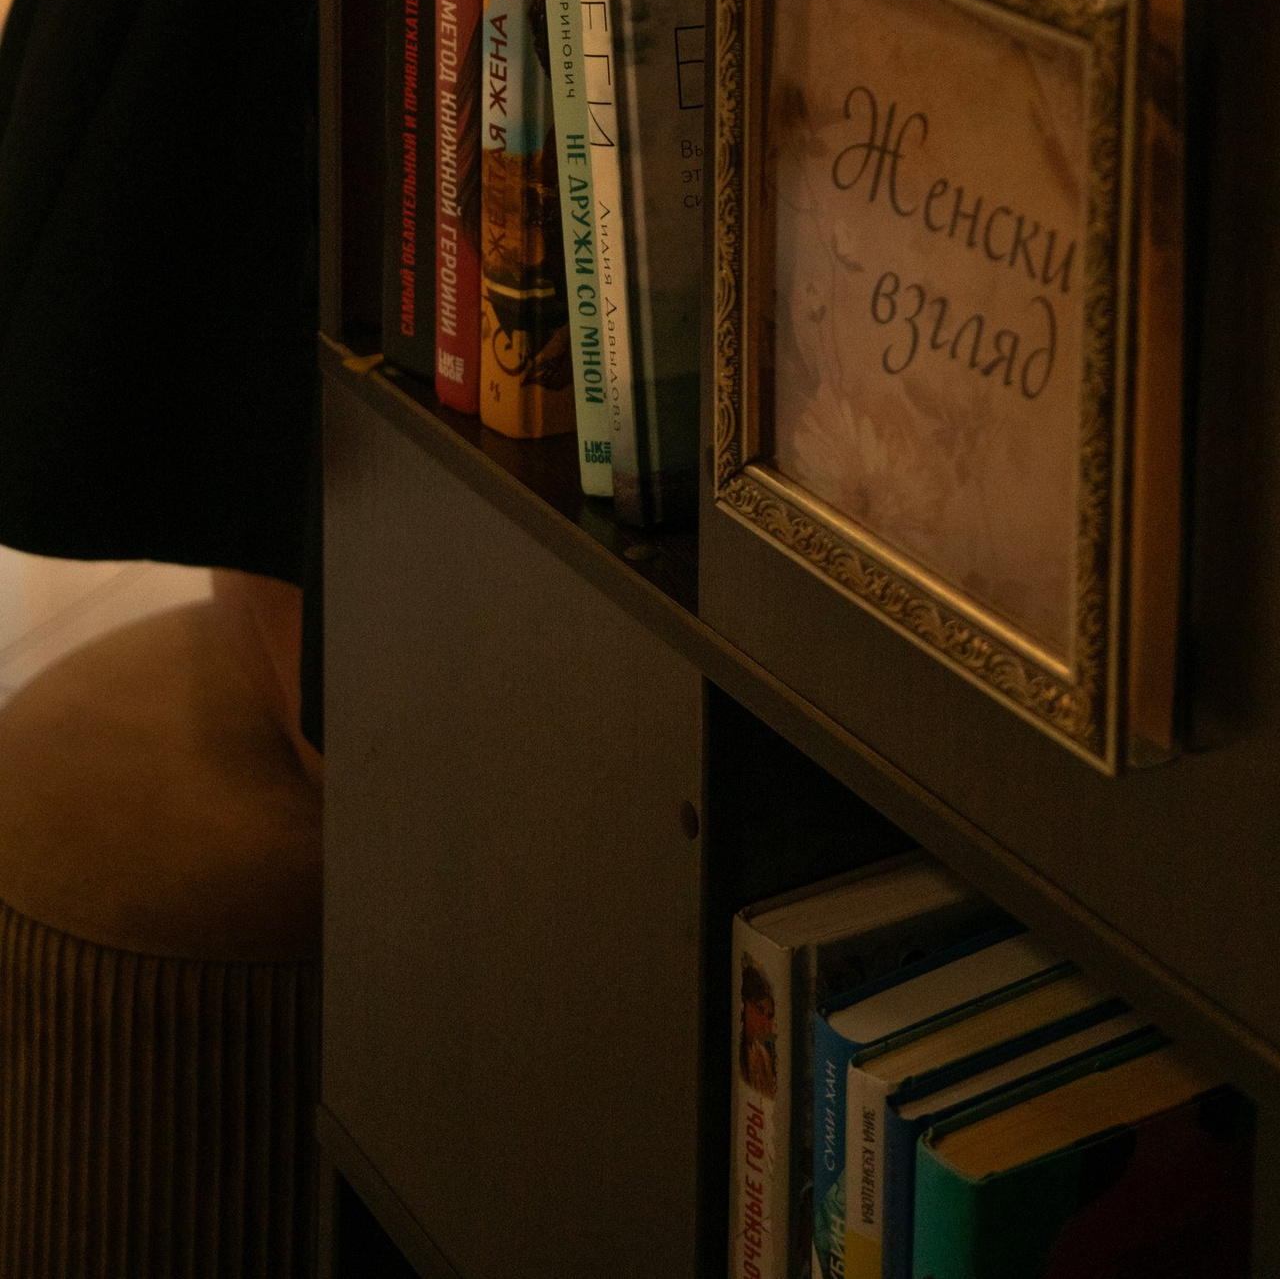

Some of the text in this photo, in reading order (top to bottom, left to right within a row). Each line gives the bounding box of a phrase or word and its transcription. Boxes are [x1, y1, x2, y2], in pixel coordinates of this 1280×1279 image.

[489, 13, 508, 116] ЖЕНА
[440, 0, 462, 337] МЕТОД КНИЖНОЙ ГЕРОИНИ
[831, 85, 1076, 294] Женски
[566, 134, 607, 405] НЕ ДРУЖИ СО МНОЙ
[871, 270, 1058, 400] взгляд
[584, 440, 612, 454] LIKE
[584, 452, 612, 465] BOOK
[745, 1101, 765, 1174] ГОРЫ
[823, 1060, 837, 1172] СУМИ ХАН
[861, 1106, 876, 1225] ЗИНА КУЗНЕЦОВА
